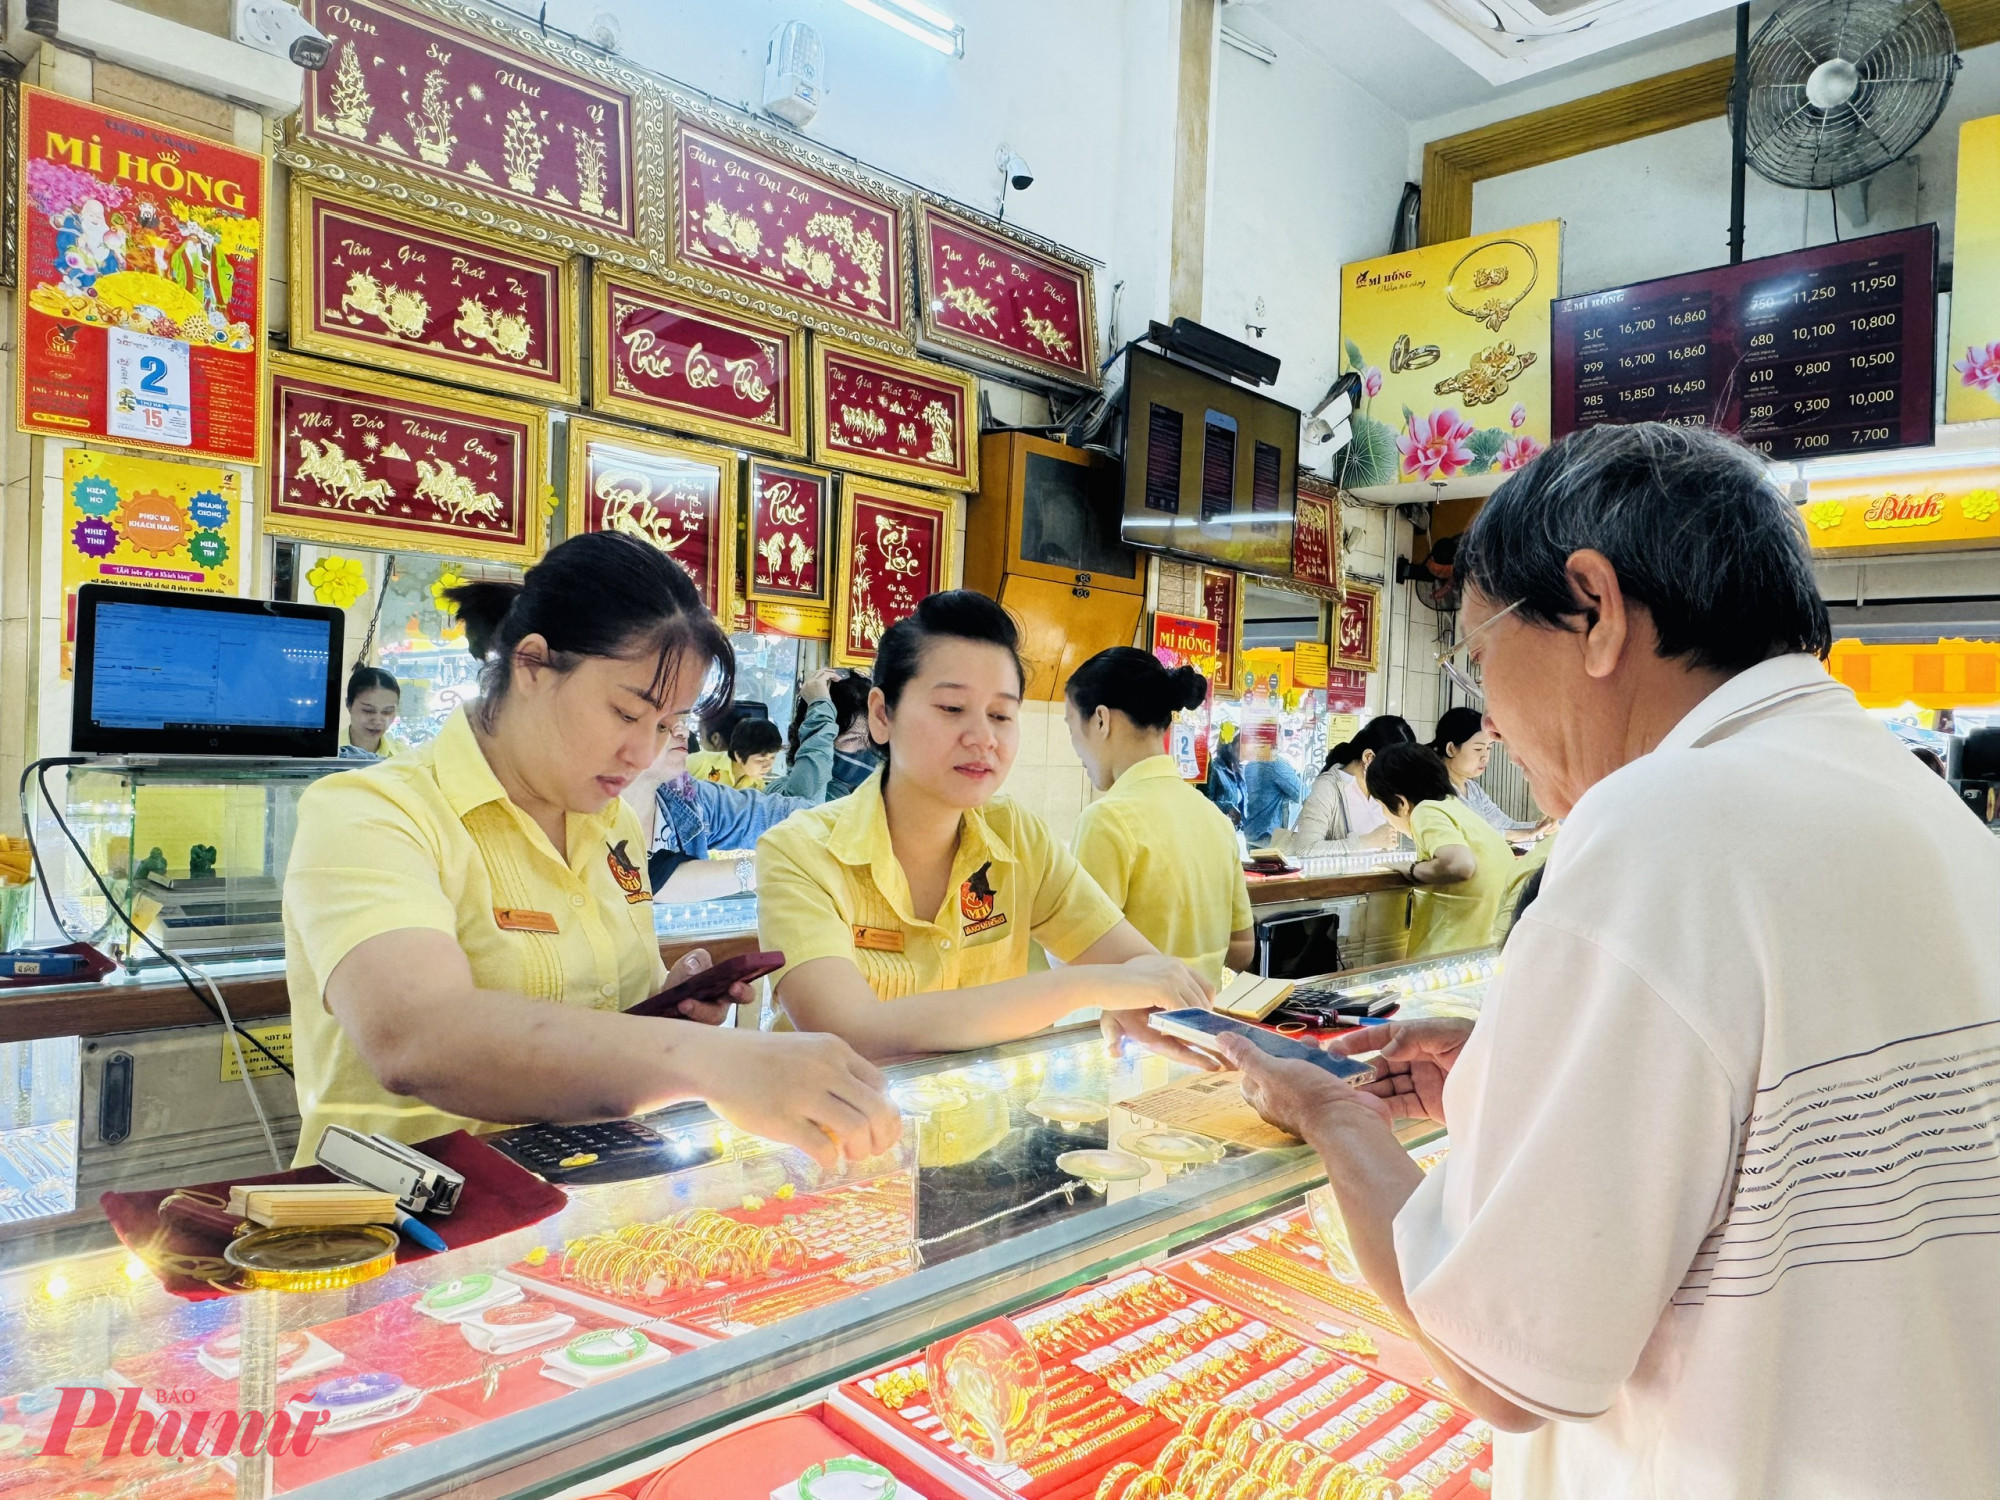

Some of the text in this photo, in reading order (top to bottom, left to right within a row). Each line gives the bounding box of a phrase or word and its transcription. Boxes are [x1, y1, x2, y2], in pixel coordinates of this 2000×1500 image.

[327, 5, 378, 36] Vạn
[341, 240, 529, 299] Tân Gia Phát Tài
[1751, 275, 1896, 311] 750 11,250 11,950
[1583, 309, 1707, 341] SJC 16,700 16,860
[1750, 313, 1896, 347] 680 10,100 10,800
[140, 355, 168, 395] 2
[1583, 345, 1706, 374] 999 16,700 16,860
[1750, 351, 1895, 383] 610 9,800 10,500
[1583, 379, 1706, 407] 985 15,850 16,450
[1750, 389, 1894, 418] 580 9,300 10,000
[143, 408, 163, 428] 15
[299, 411, 498, 465] Mã Đáo Thành Công
[1794, 434, 1830, 450] 7,000
[1852, 427, 1889, 444] 7,700
[1181, 736, 1189, 756] 2
